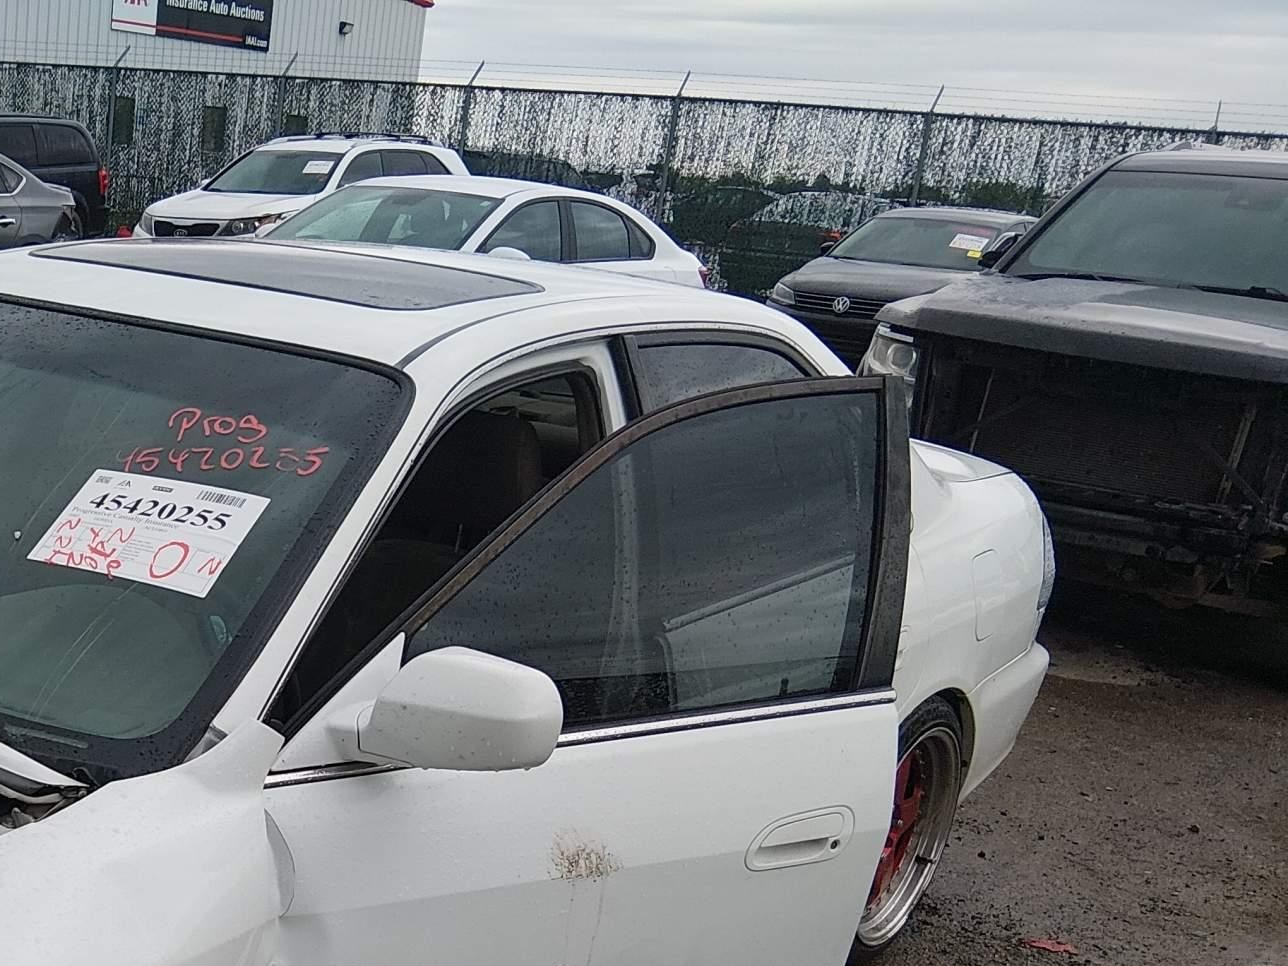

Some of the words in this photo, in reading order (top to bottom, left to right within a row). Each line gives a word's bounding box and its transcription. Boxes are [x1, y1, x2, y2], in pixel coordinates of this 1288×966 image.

[209, 1, 229, 16] Auto
[230, 3, 265, 22] Auctions
[168, 407, 270, 443] Prog
[89, 492, 232, 531] 45420255
[145, 517, 178, 529] Insurance
